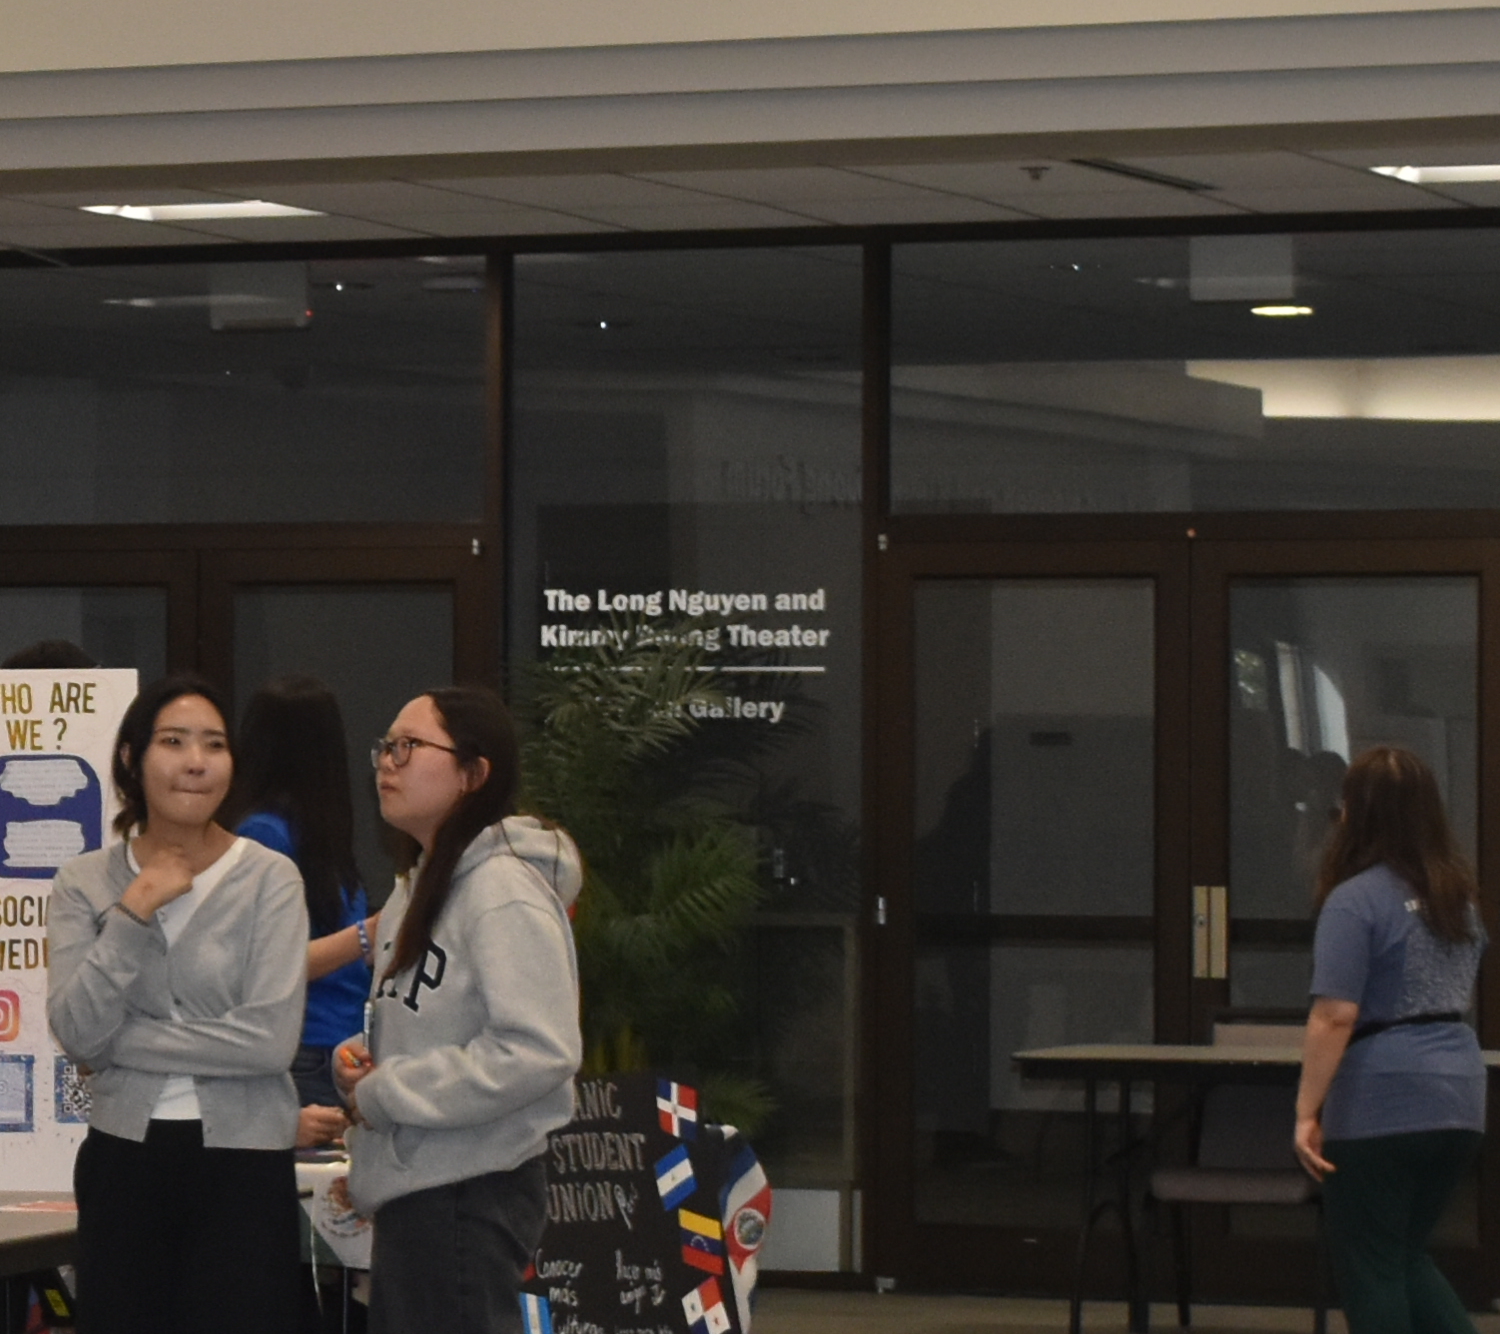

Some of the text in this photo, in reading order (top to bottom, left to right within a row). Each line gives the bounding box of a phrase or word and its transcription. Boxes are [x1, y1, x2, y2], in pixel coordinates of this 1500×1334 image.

[543, 588, 826, 616] The Long Nguyen and
[726, 624, 830, 648] Theater
[49, 682, 97, 714] ARE
[6, 717, 68, 751] WE ?
[551, 1131, 646, 1174] STUDENT
